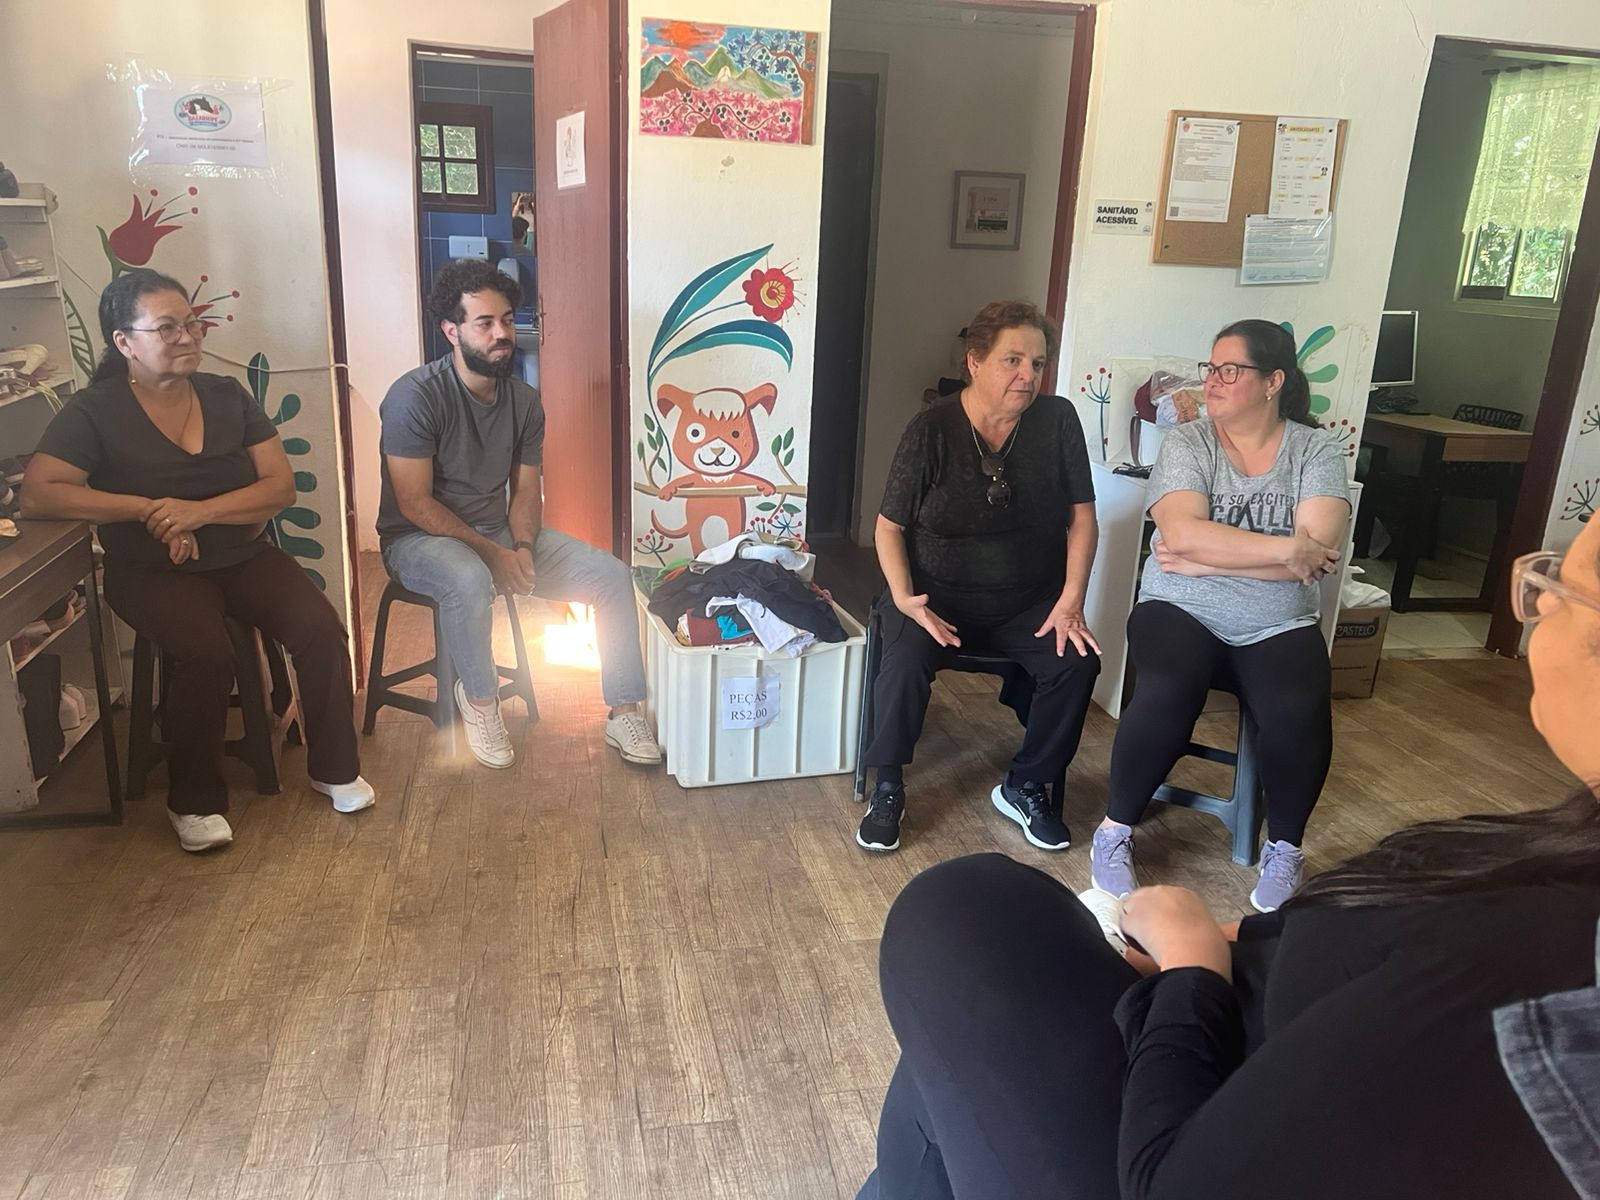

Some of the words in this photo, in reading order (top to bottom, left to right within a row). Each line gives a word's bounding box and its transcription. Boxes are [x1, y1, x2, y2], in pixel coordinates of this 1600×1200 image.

[1097, 206, 1138, 215] SANITÁRIO
[1096, 216, 1138, 224] ACESSÍVEL
[1229, 494, 1244, 505] SO
[1250, 493, 1295, 507] EXCITED
[1335, 625, 1376, 637] CASTELO
[729, 690, 767, 705] PEÇAS
[731, 708, 767, 721] R$2,00
